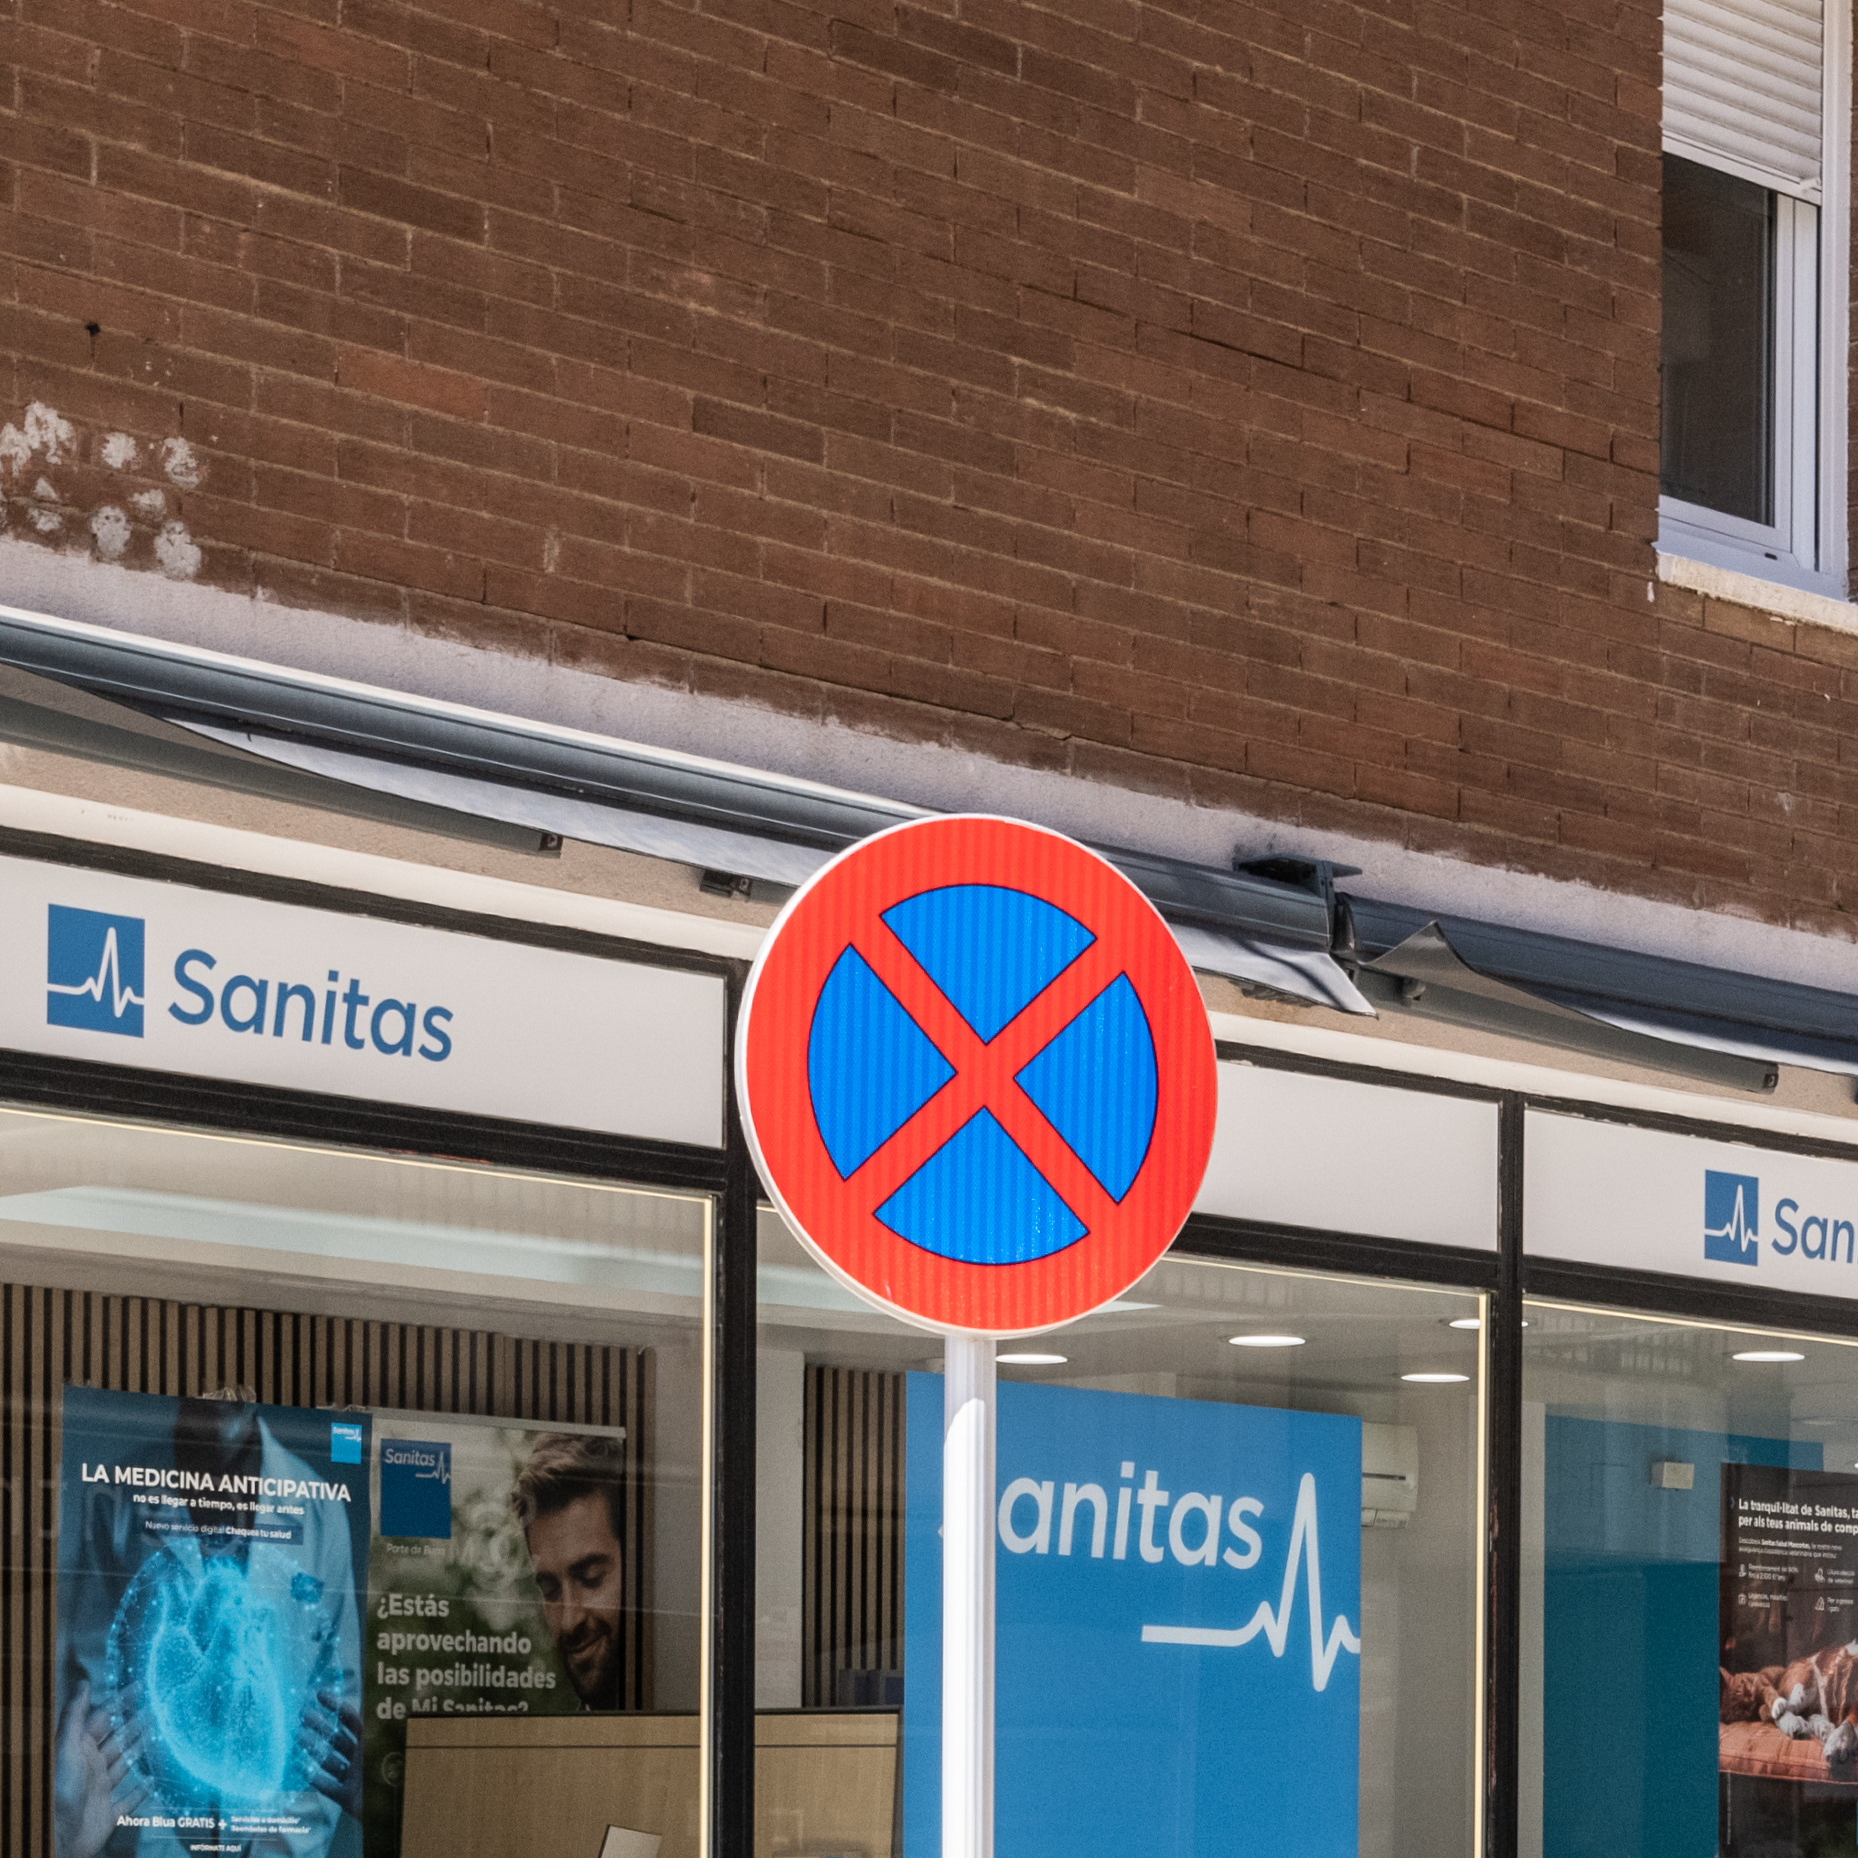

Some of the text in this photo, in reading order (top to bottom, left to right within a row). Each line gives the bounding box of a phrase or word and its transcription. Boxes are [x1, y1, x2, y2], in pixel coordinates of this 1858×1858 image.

[168, 948, 454, 1063] Sanitas
[333, 1427, 355, 1435] Sanitas
[385, 1449, 435, 1467] Sanitas
[82, 1463, 351, 1502] LA MEDICINA ANTICIPATIVA
[133, 1493, 146, 1503] no
[147, 1495, 160, 1504] es
[161, 1494, 188, 1508] llegar
[198, 1497, 235, 1511] tiempo,
[237, 1502, 248, 1511] es
[250, 1502, 274, 1515] llegar
[277, 1505, 304, 1515] antes
[1738, 1498, 1748, 1510] La
[1800, 1504, 1812, 1516] de
[1814, 1504, 1850, 1520] Sanitas,
[939, 1461, 1264, 1570] anitas
[1738, 1516, 1752, 1528] per
[1753, 1515, 1765, 1528] als
[1766, 1517, 1783, 1529] teus
[1785, 1519, 1819, 1532] animals
[1820, 1520, 1832, 1532] de
[145, 1520, 169, 1530] Nuevo
[200, 1524, 224, 1536] digital
[270, 1528, 292, 1539] salud
[386, 1543, 409, 1553] Parte
[411, 1544, 422, 1554] de
[377, 1593, 450, 1619] ¿Estás
[377, 1629, 532, 1655] aprovechando
[377, 1661, 556, 1691] las posibilidades
[376, 1697, 407, 1720] de
[117, 1815, 150, 1827] Ahora
[152, 1816, 175, 1828] Blua
[177, 1818, 215, 1829] GRATIS
